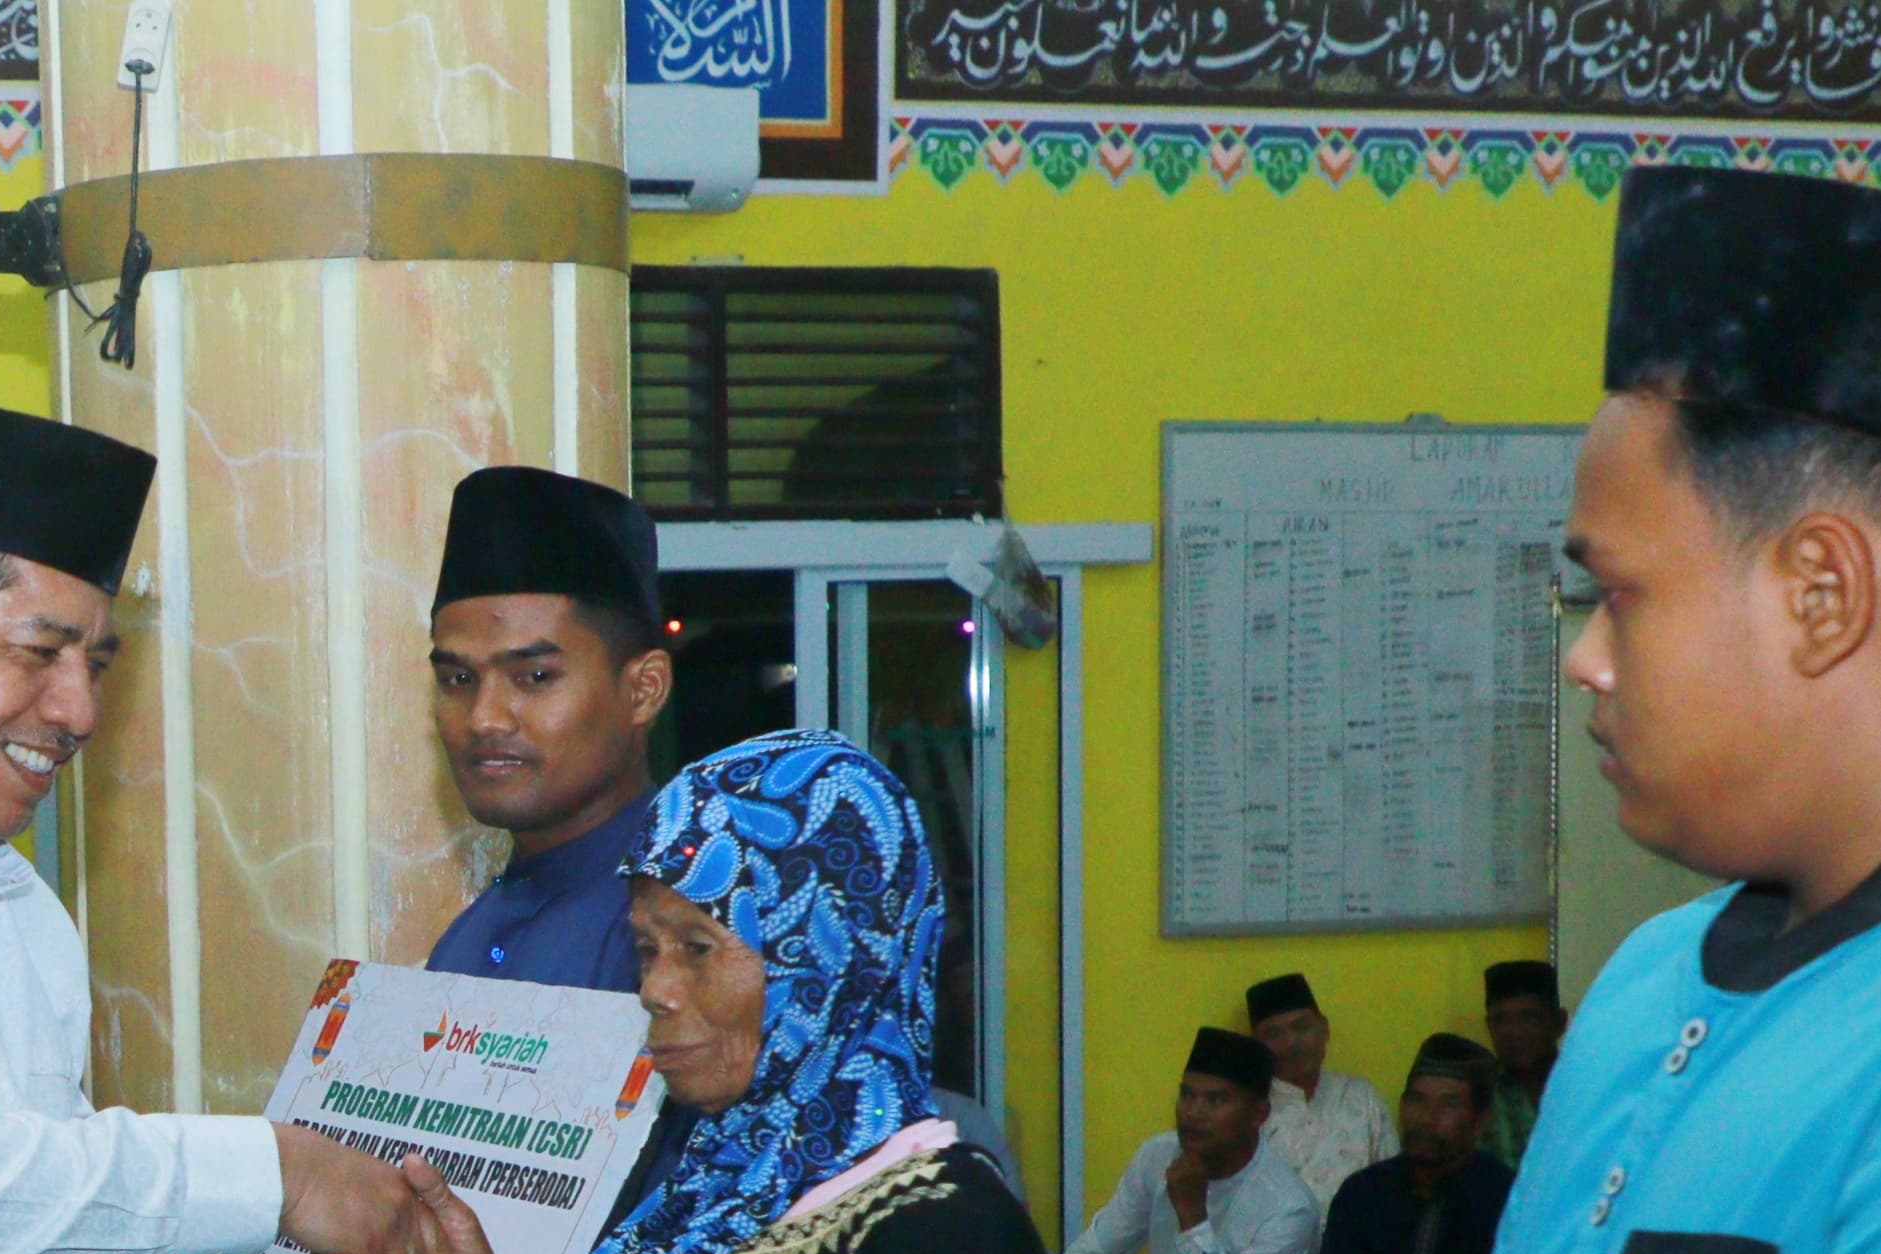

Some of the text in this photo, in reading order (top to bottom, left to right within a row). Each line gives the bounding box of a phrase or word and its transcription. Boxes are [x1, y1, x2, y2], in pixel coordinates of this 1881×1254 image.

[445, 1020, 549, 1065] brksyariah
[320, 1079, 421, 1129] PROGRAM
[412, 1096, 535, 1150] KEMITRAAN
